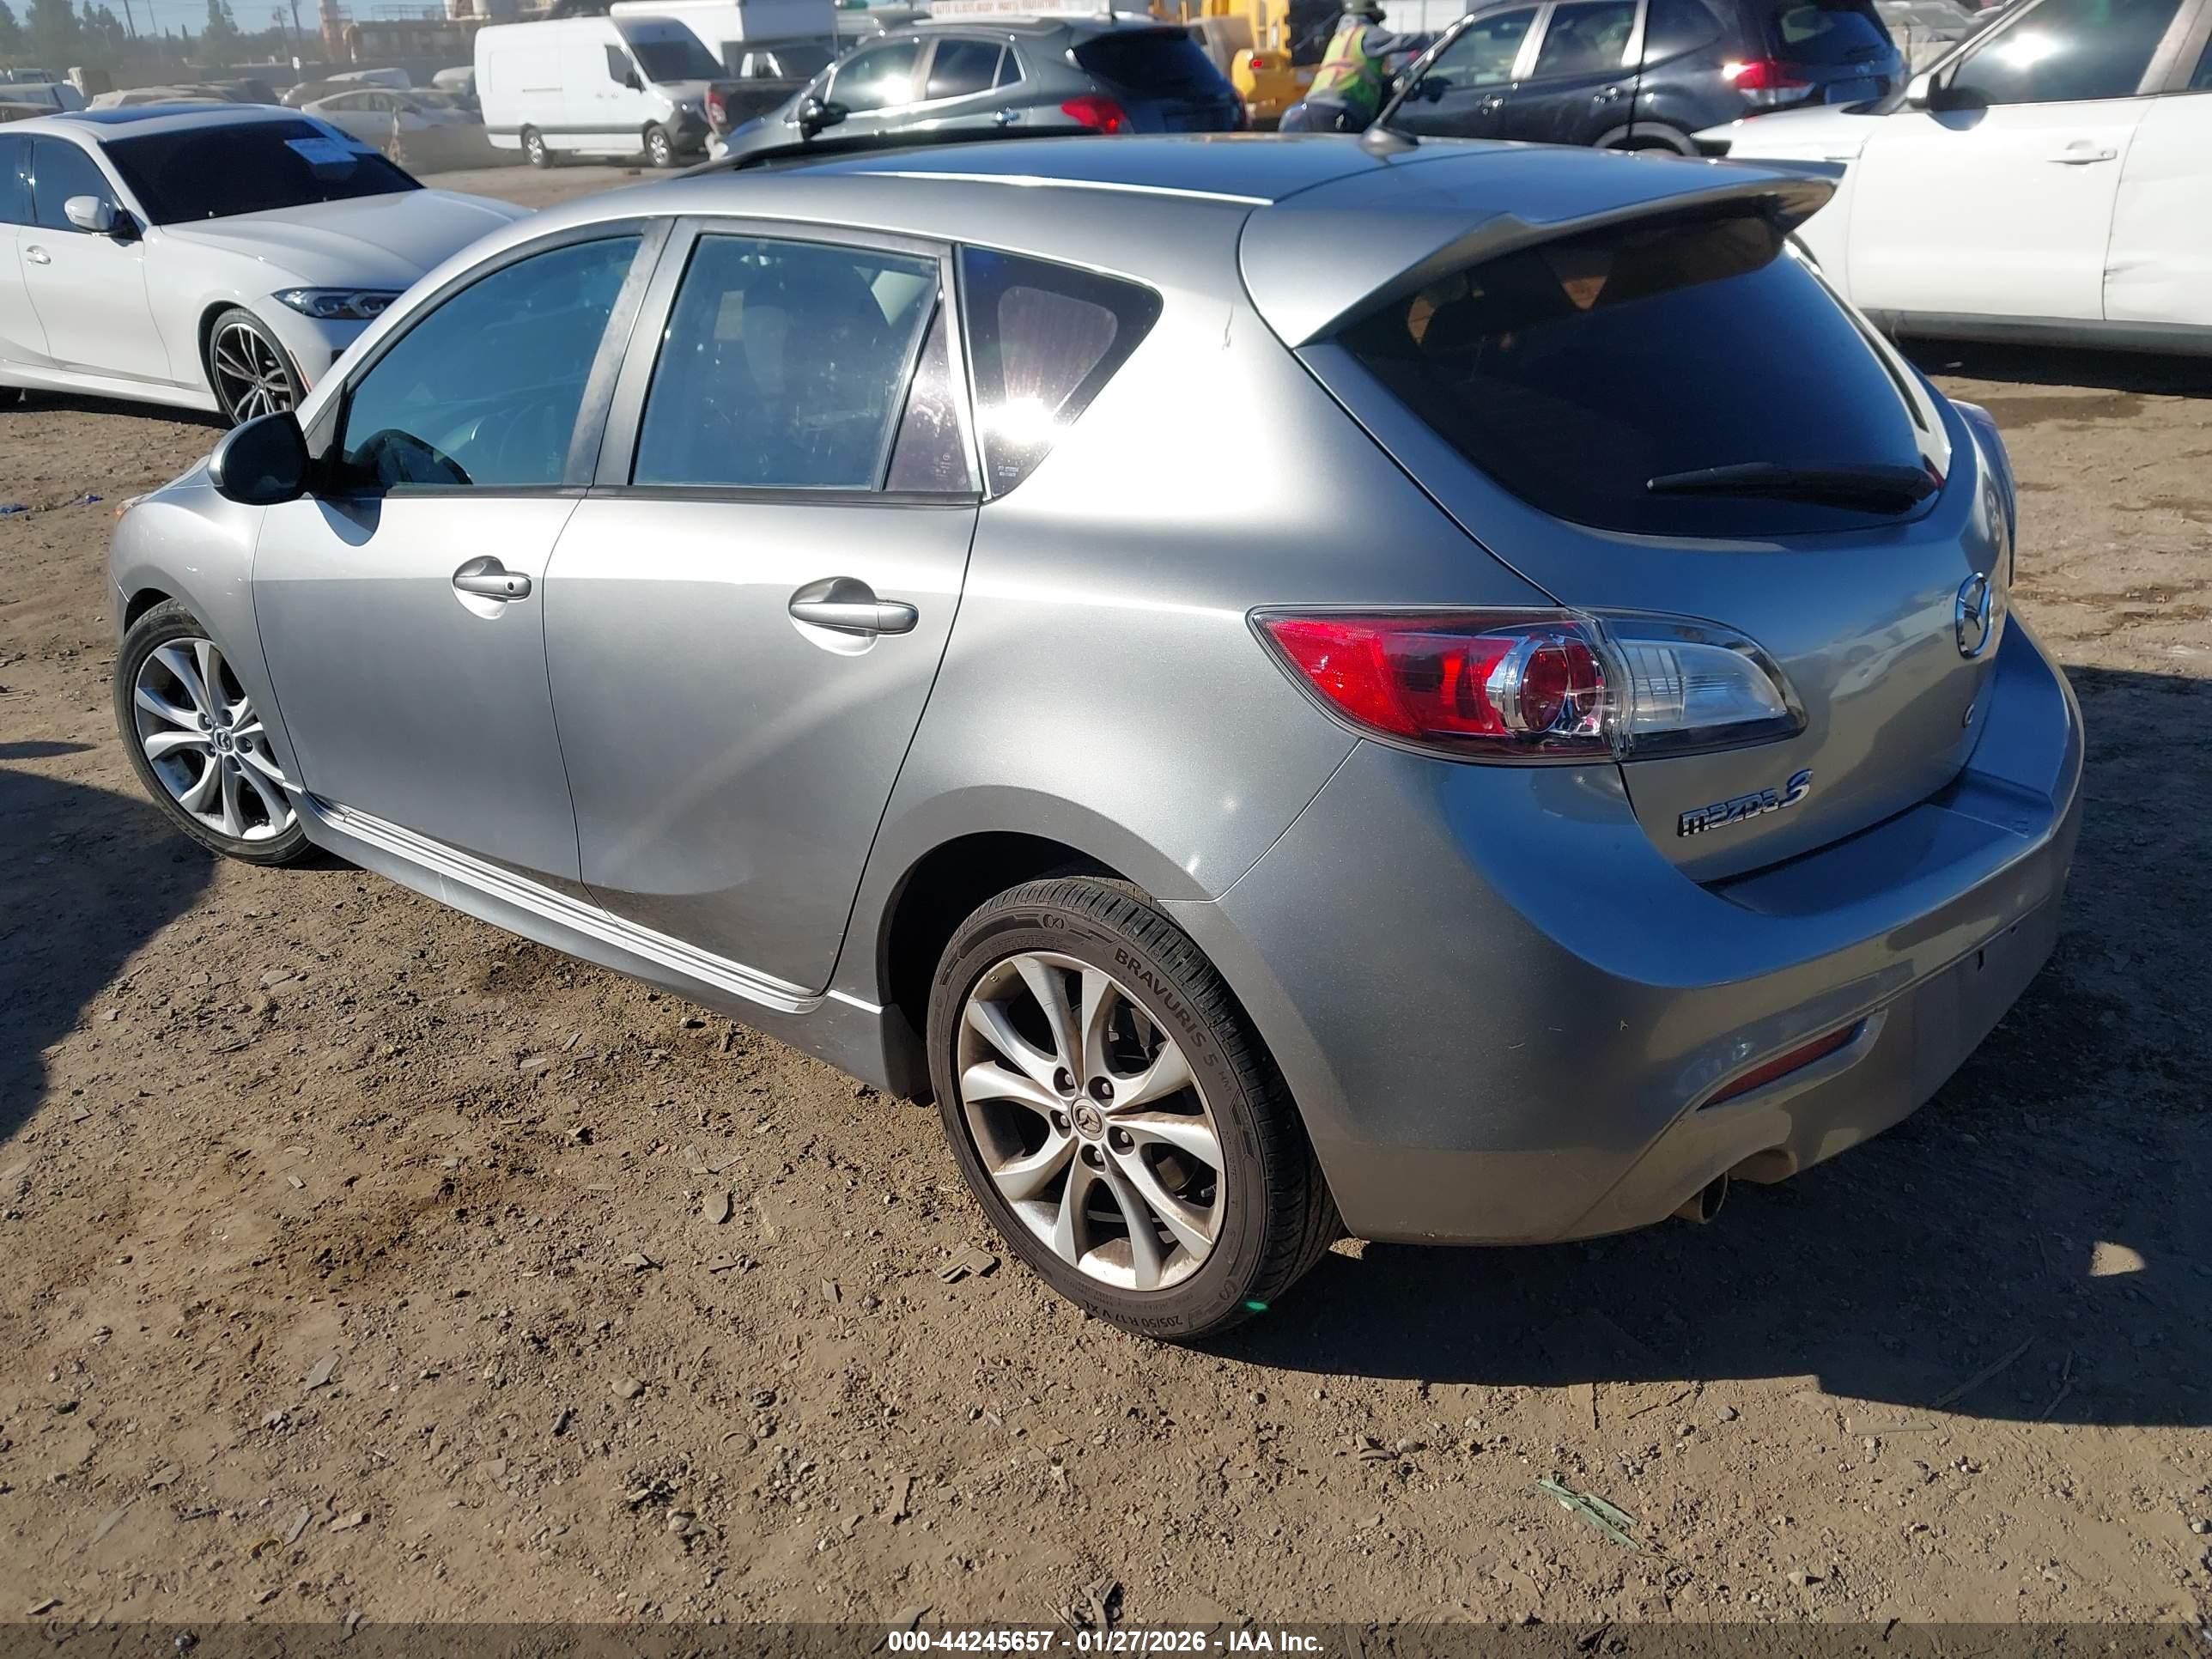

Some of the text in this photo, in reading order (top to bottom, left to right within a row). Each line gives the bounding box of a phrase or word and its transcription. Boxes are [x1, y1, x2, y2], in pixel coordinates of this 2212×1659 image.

[1114, 946, 1207, 1048] BRAVURIS
[1203, 1053, 1219, 1067] 5
[1140, 1315, 1183, 1328] 205/50
